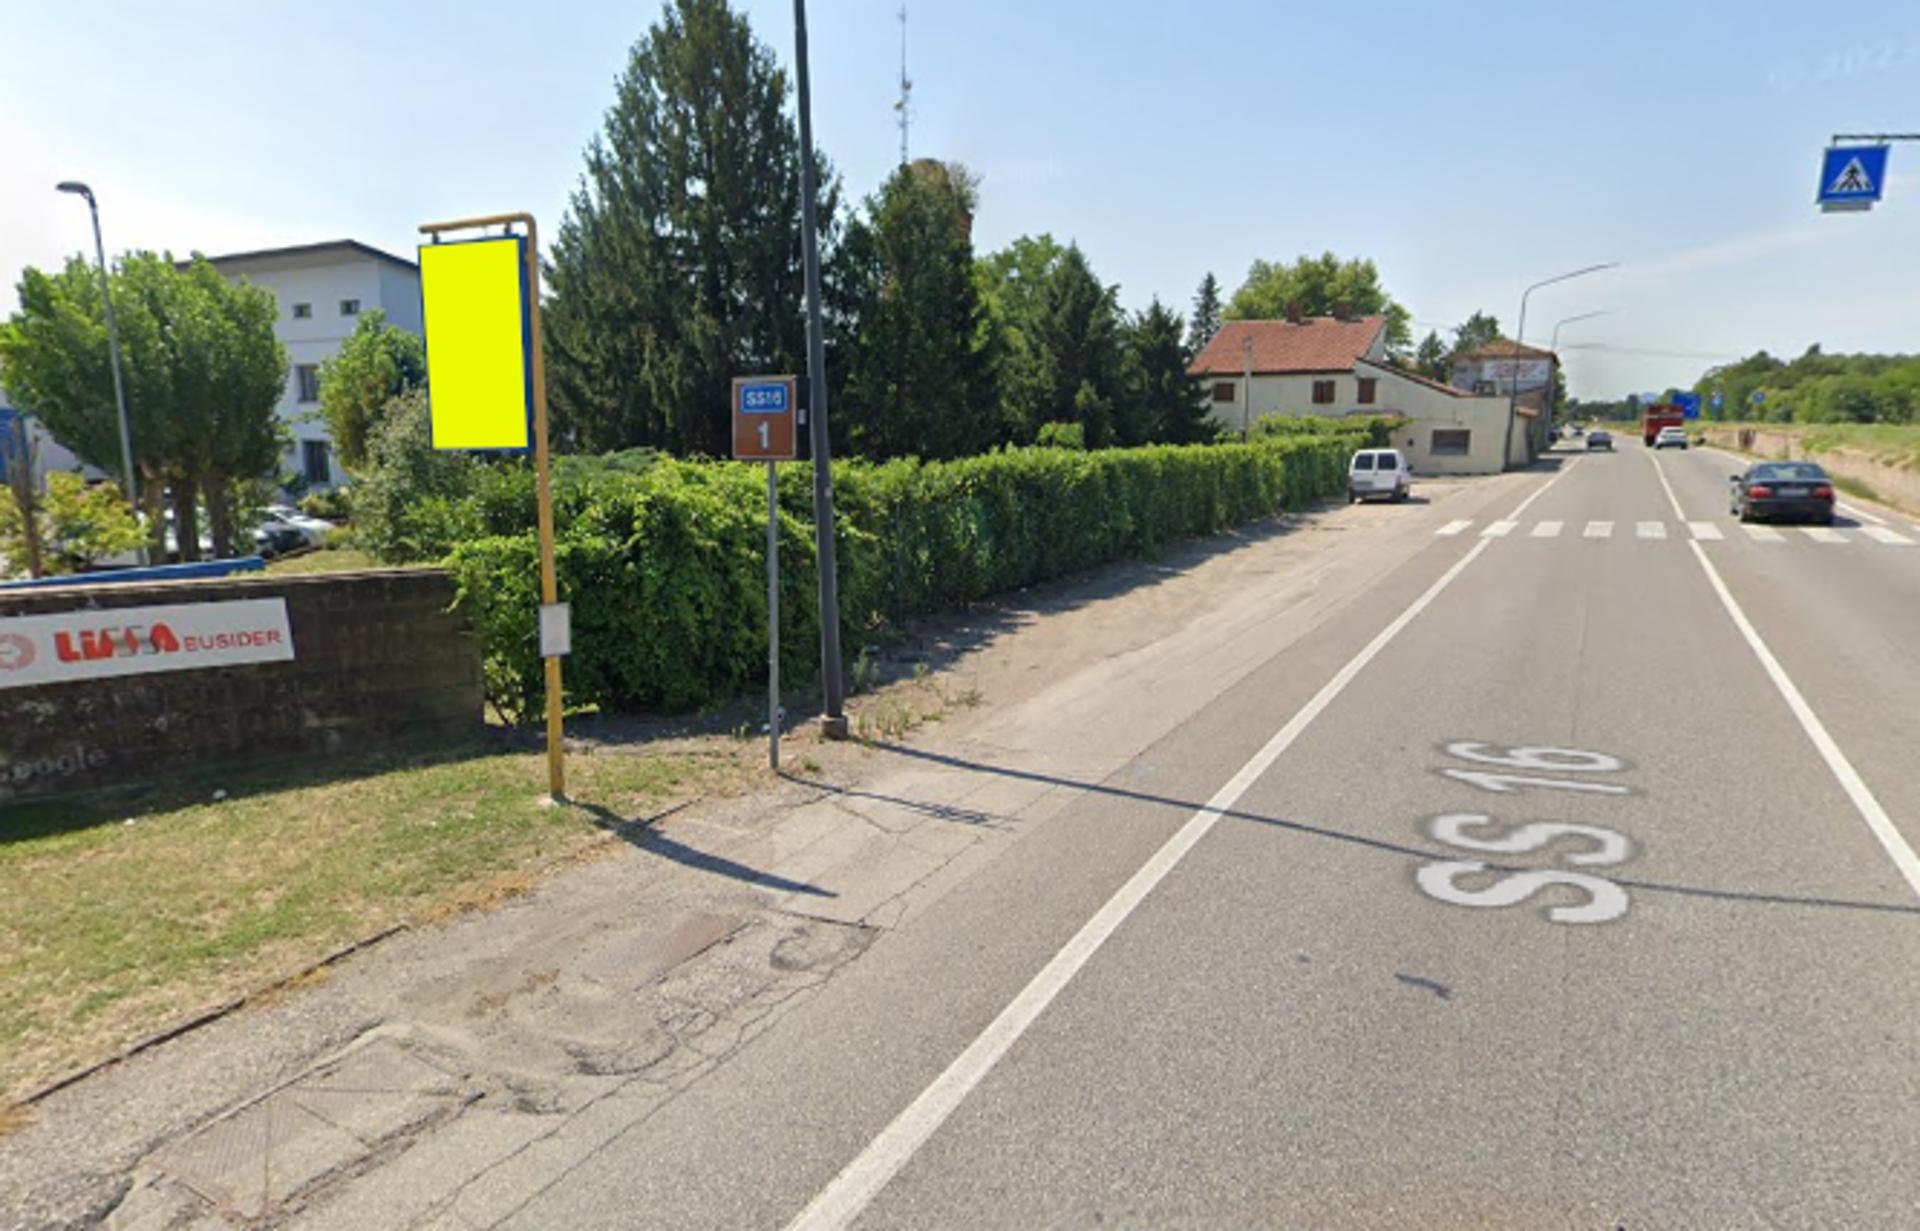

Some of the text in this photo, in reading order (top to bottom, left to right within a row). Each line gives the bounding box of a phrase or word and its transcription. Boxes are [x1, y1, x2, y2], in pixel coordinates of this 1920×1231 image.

[758, 421, 769, 450] 1
[1416, 741, 1630, 924] SS 16
